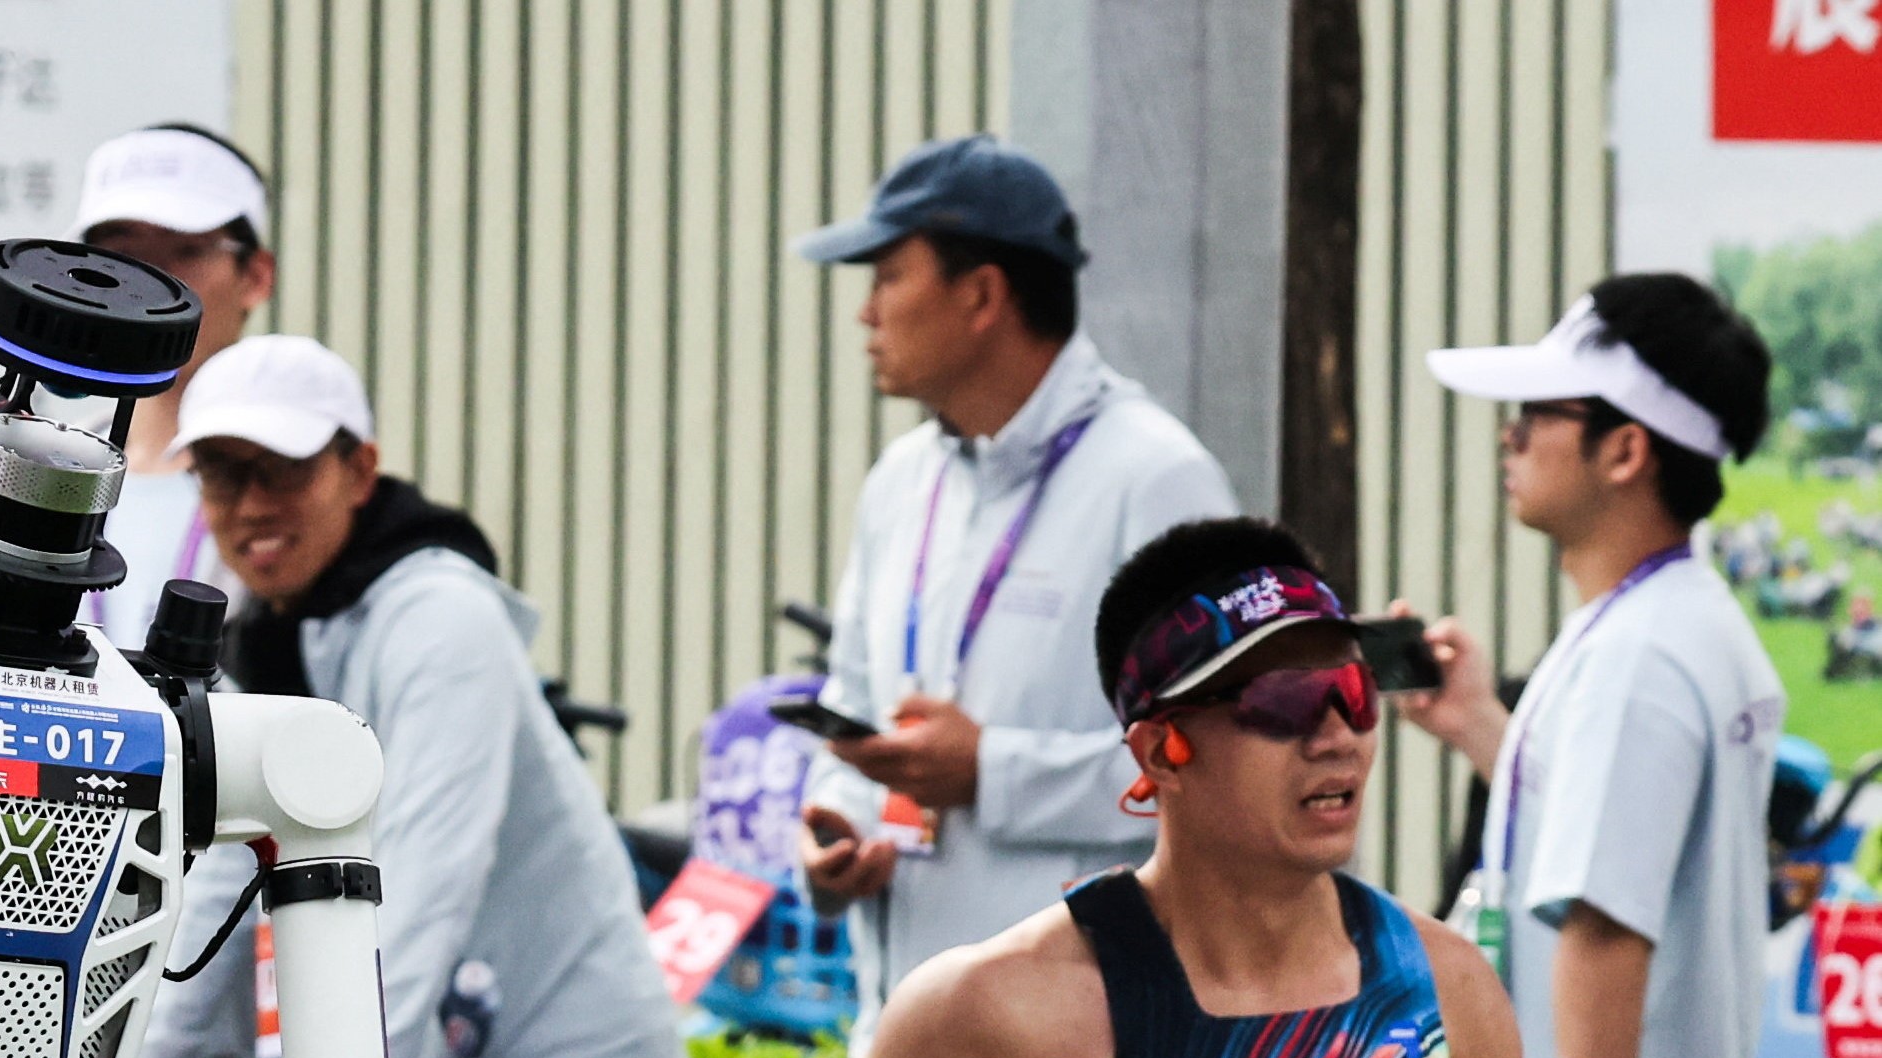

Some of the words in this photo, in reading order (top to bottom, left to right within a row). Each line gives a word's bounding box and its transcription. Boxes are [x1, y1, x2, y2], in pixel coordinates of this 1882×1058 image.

[1, 671, 99, 696] 北京机器人租赁
